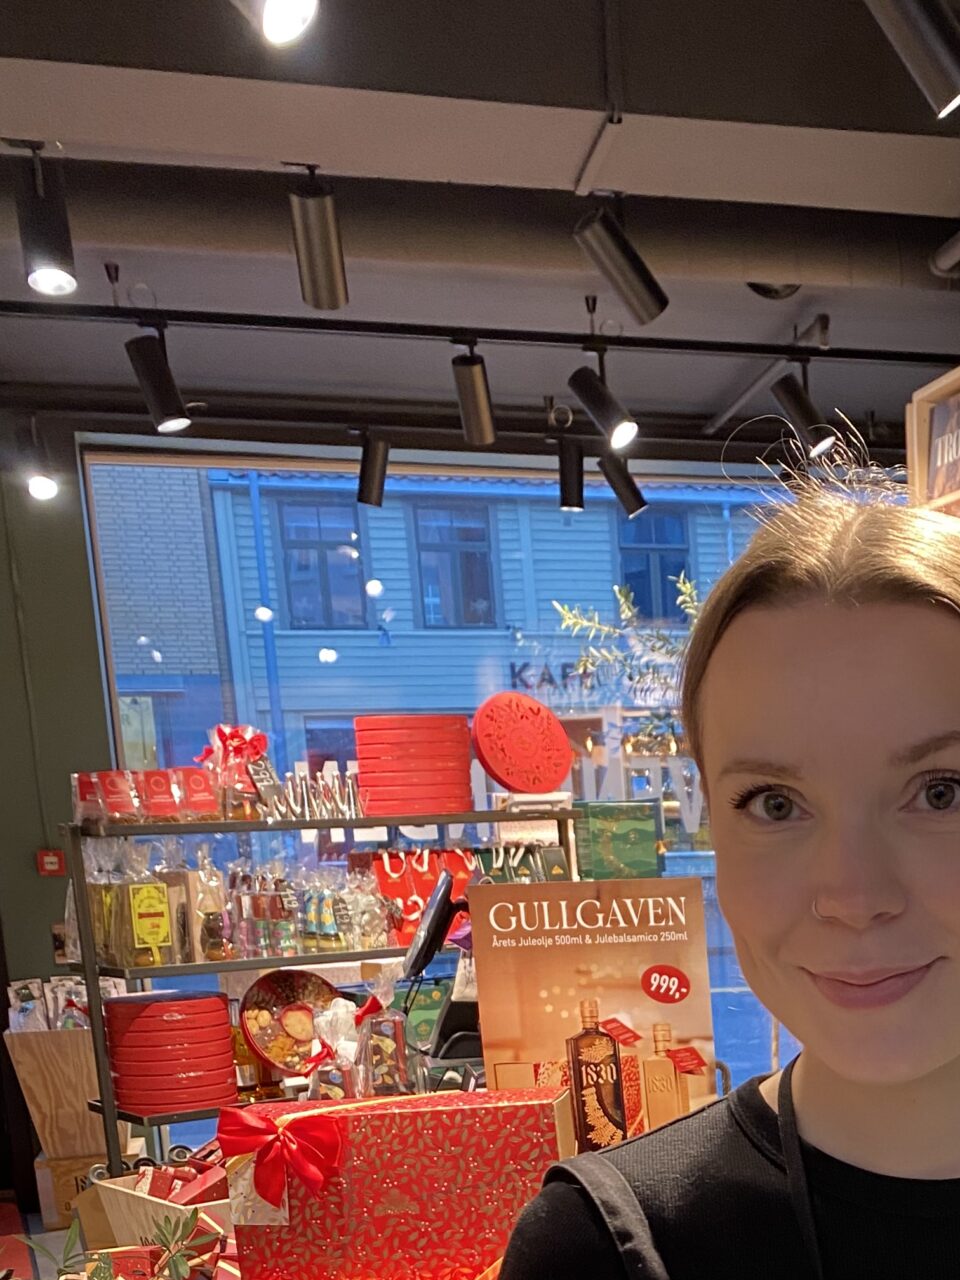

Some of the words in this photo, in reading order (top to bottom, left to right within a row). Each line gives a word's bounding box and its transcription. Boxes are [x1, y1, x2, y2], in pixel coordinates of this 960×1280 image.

[489, 897, 686, 932] GULLGAVEN
[492, 935, 516, 948] Årets
[518, 934, 553, 947] Juleolje
[555, 933, 583, 945] 500ml
[584, 933, 592, 944] &
[594, 932, 658, 943] Julebalsamico
[660, 931, 688, 942] 250ml
[650, 973, 688, 999] 999,-
[581, 1063, 617, 1086] 1830
